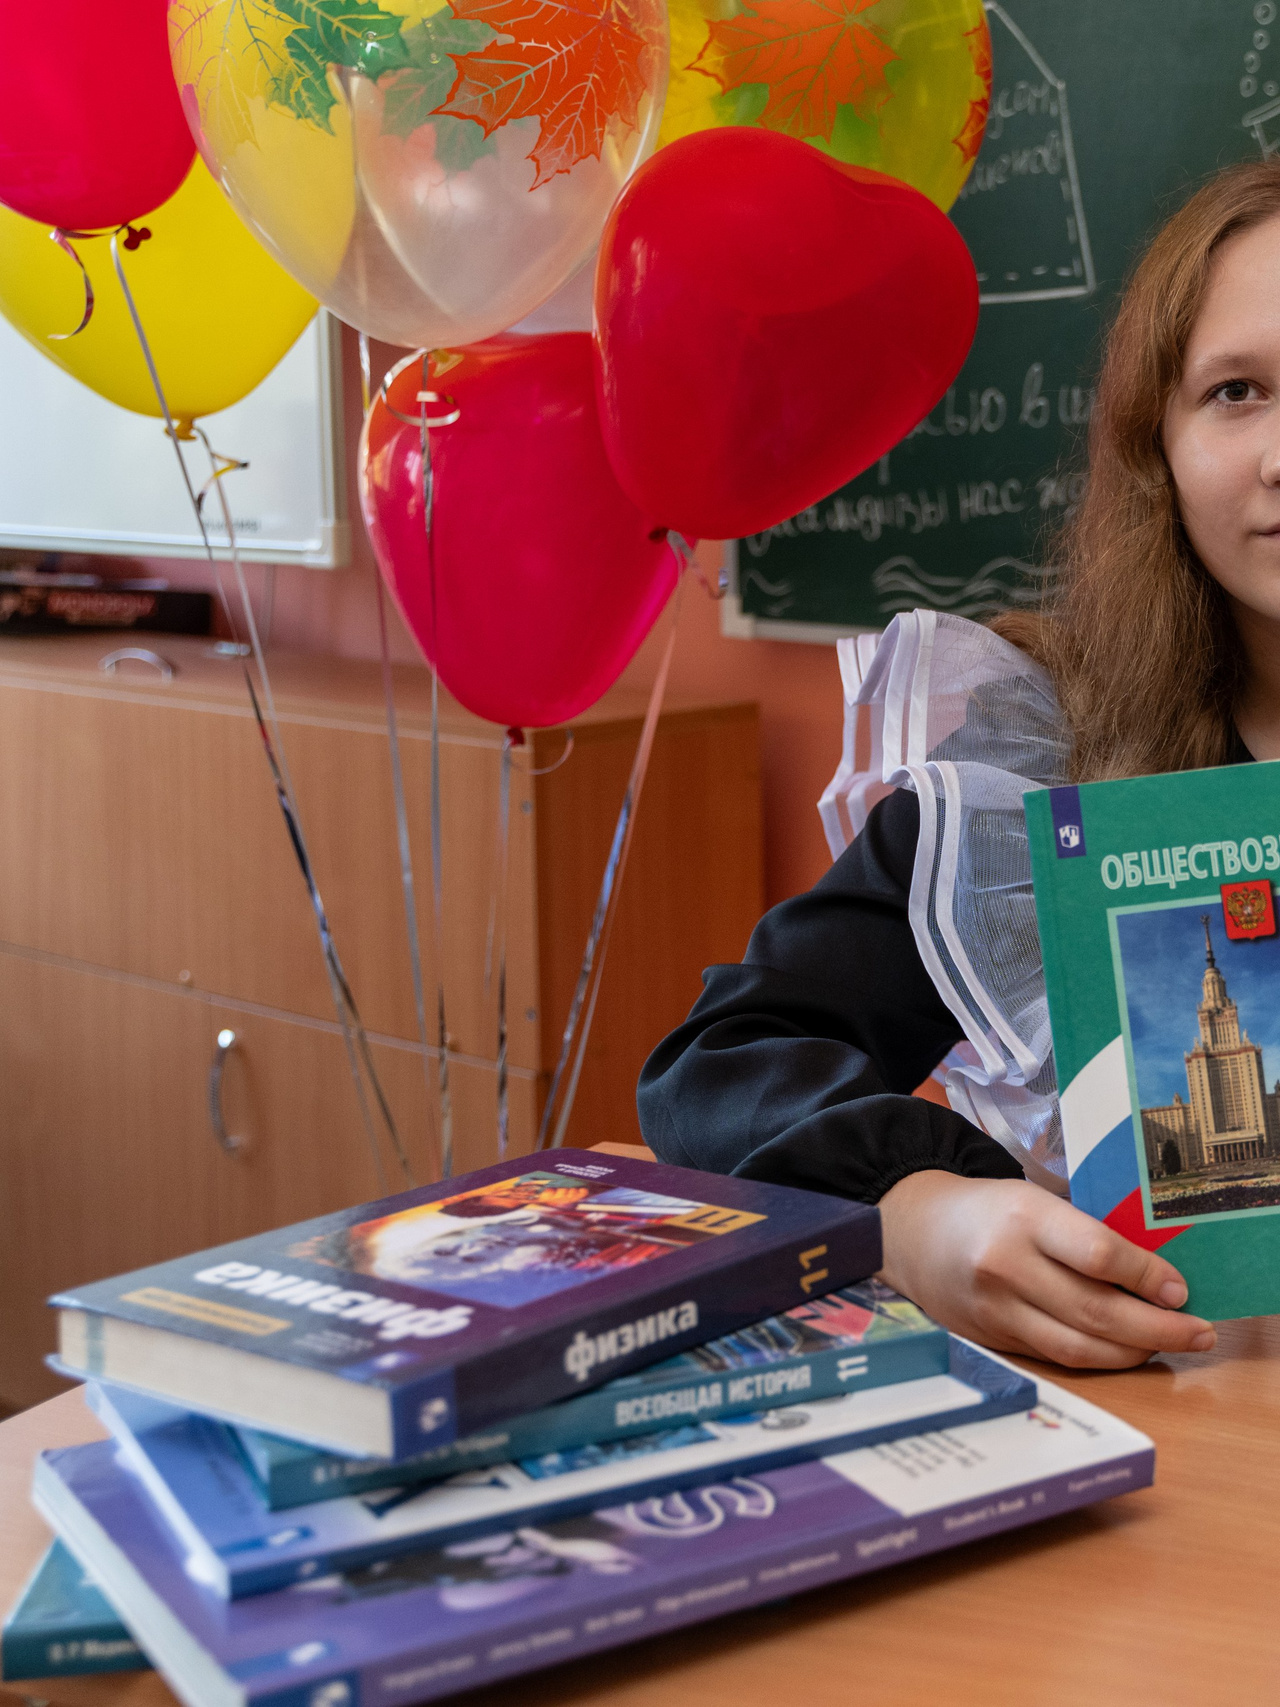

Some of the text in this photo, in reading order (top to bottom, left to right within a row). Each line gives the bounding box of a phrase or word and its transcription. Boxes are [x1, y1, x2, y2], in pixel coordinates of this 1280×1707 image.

[798, 1243, 829, 1294] 11
[615, 1354, 869, 1428] ВСЕОБЩАЯ ИСТОРИЯ 11
